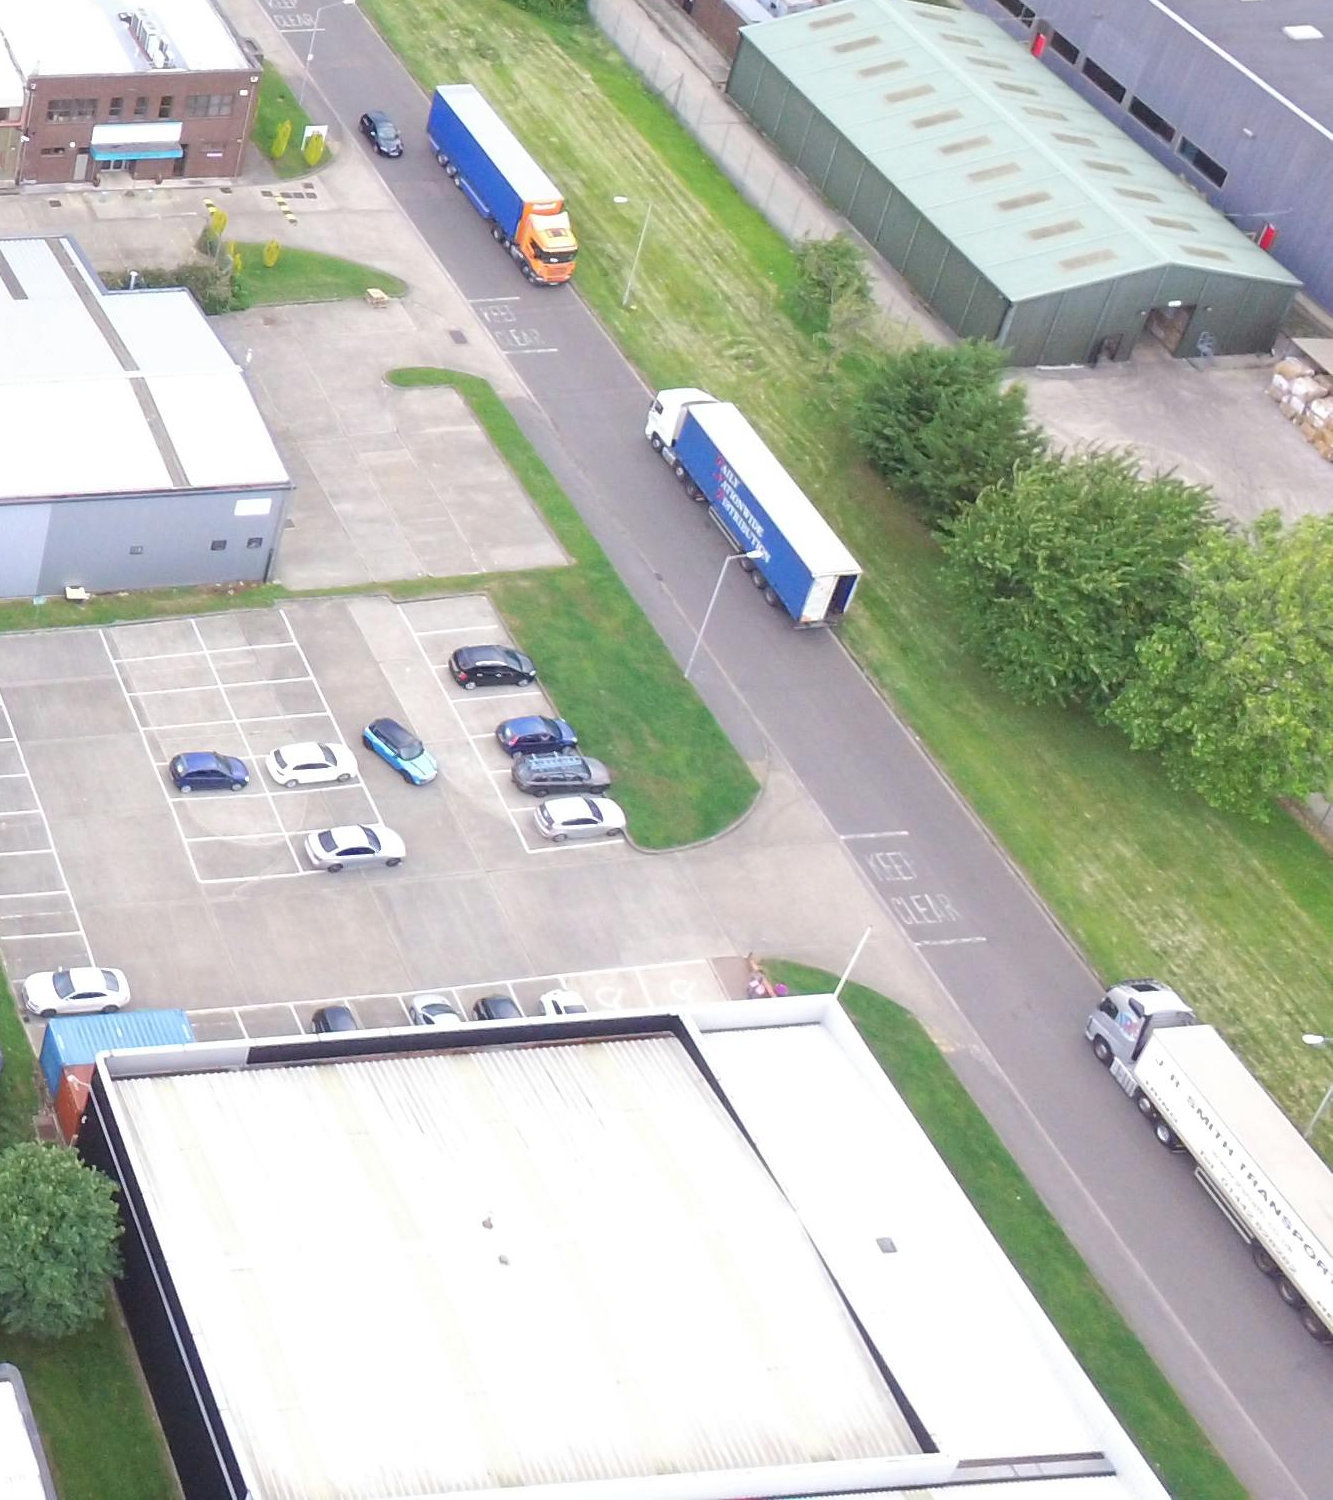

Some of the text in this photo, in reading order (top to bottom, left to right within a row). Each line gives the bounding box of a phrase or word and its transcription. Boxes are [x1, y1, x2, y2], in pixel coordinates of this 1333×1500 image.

[713, 471, 765, 538] NATIONWIDE
[716, 487, 771, 564] DISTRIBUTION
[864, 852, 917, 882] KEEP
[890, 893, 962, 925] CLEAR
[1187, 1094, 1234, 1157] SMITH
